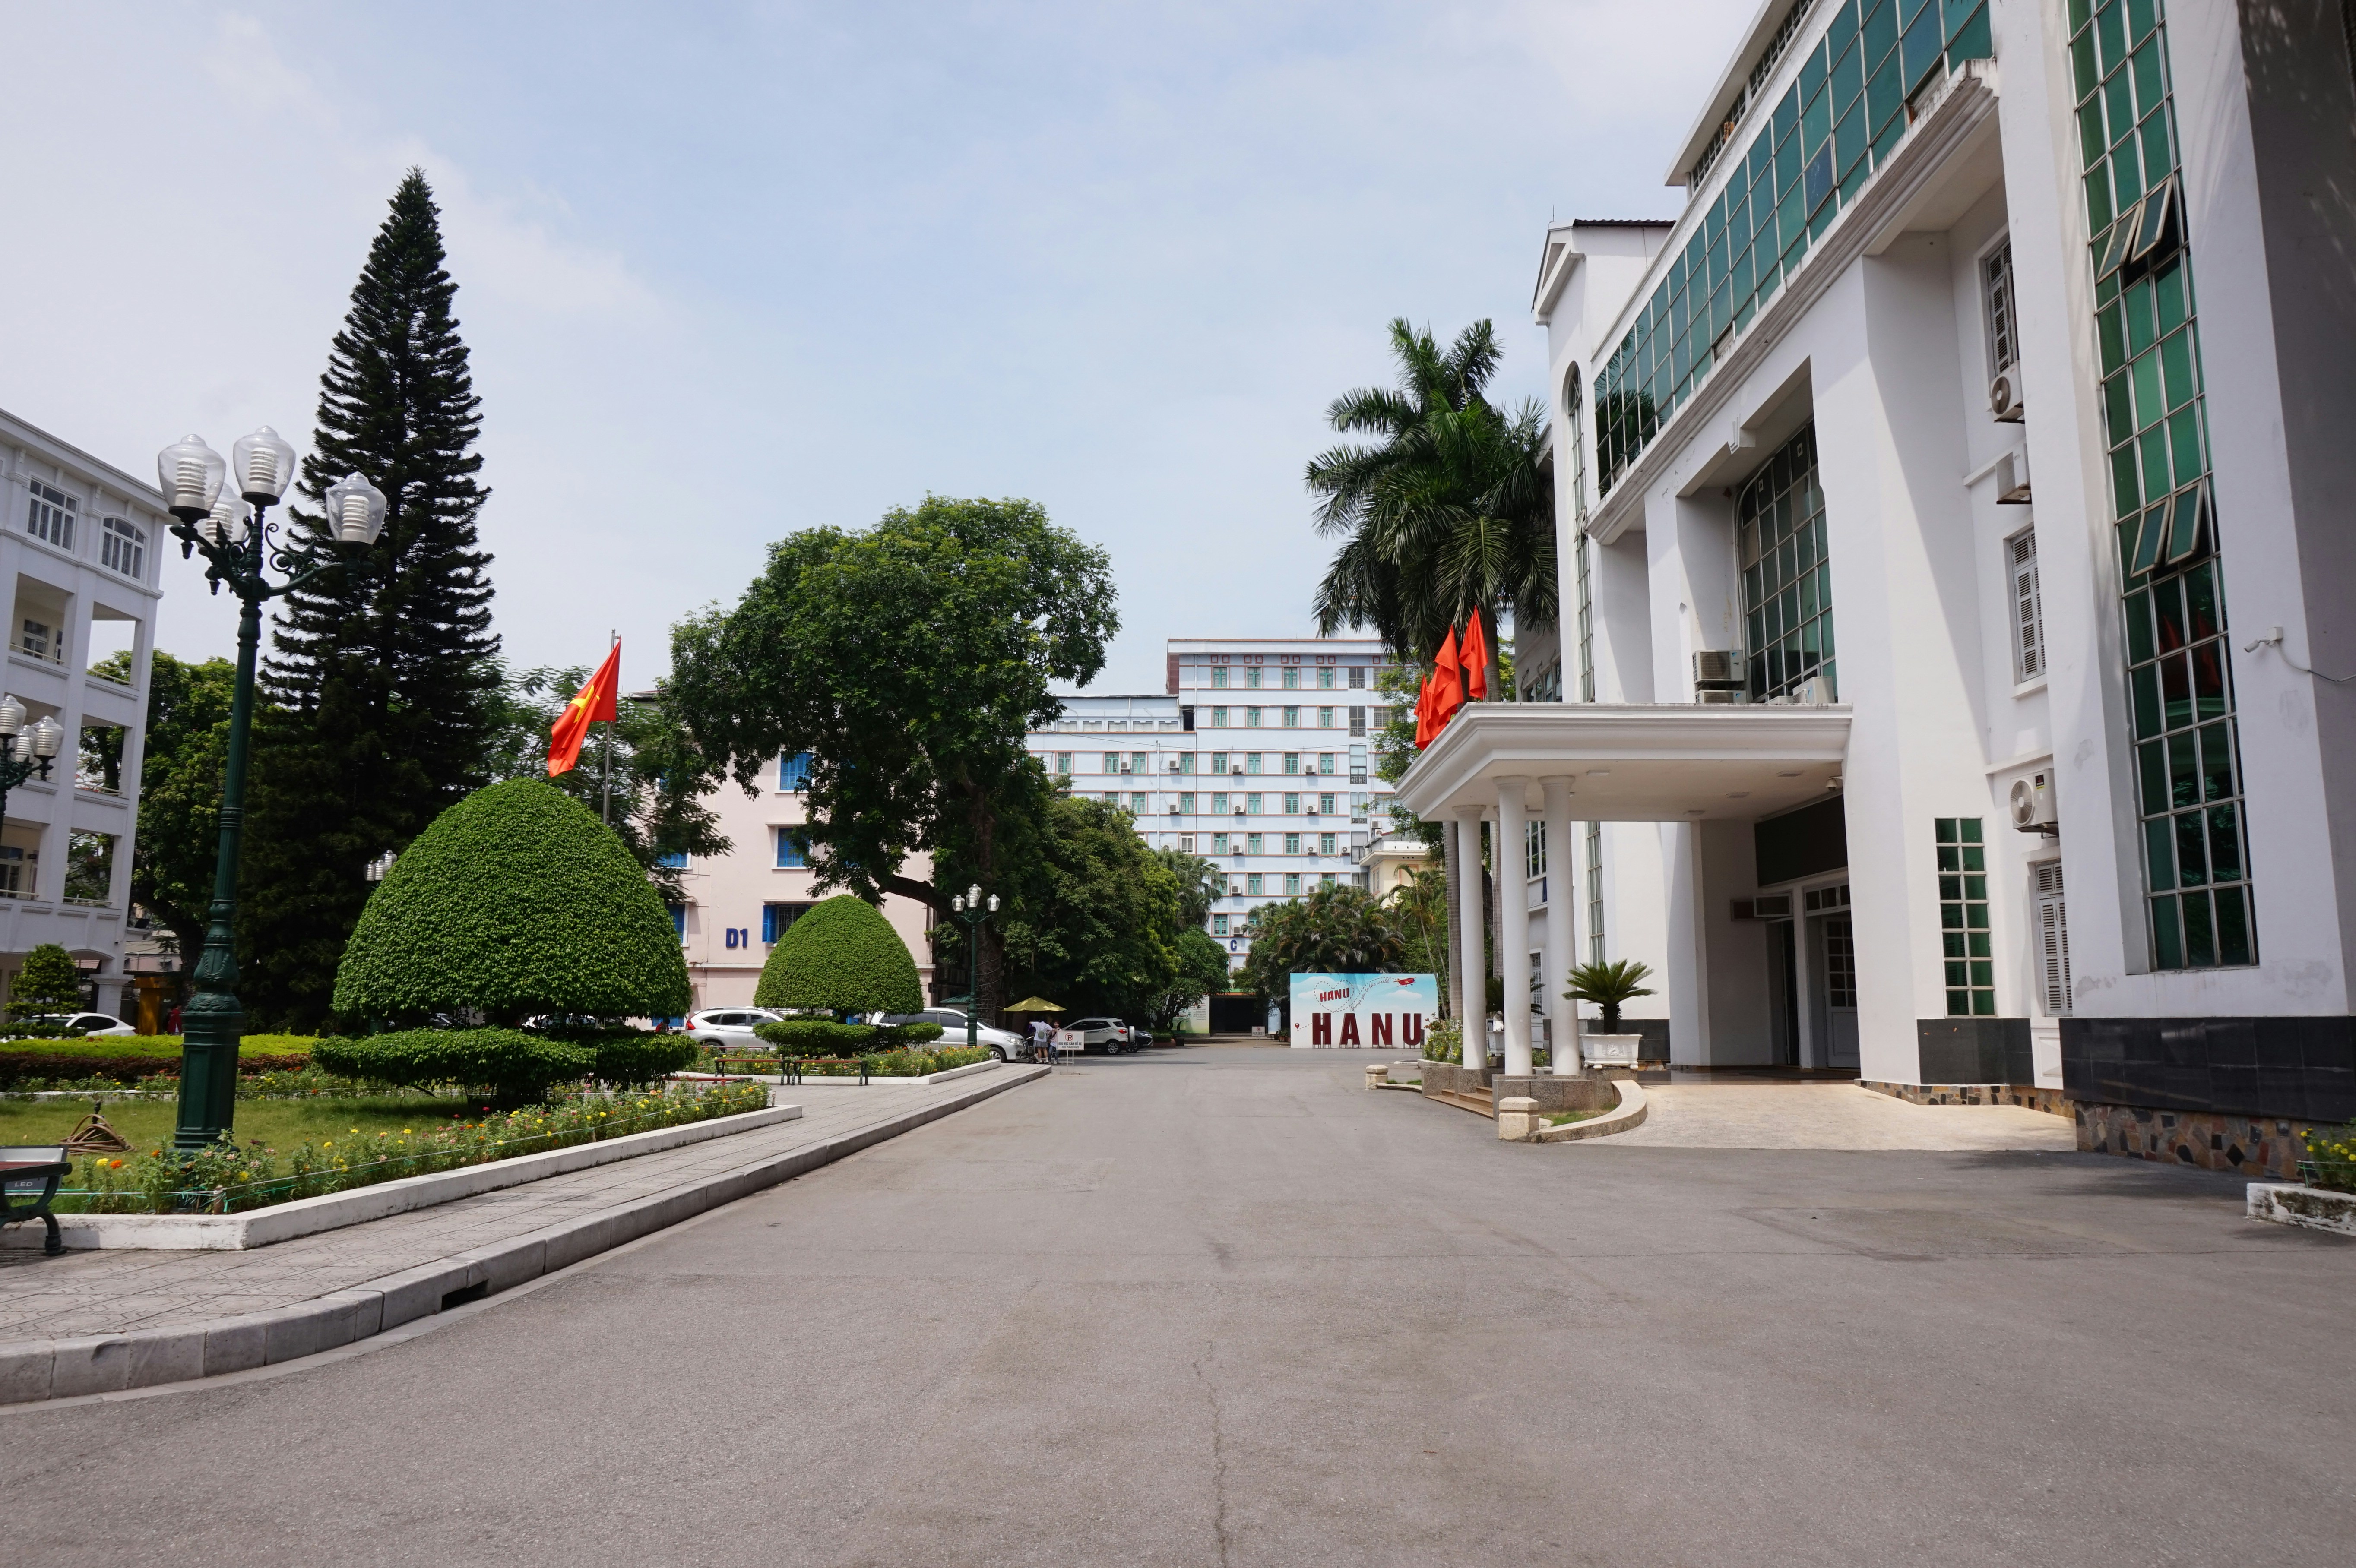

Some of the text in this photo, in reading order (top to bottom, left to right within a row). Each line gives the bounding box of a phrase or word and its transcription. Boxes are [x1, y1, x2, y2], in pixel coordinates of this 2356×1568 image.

[726, 928, 747, 948] D1
[1230, 939, 1237, 951] C
[1320, 987, 1349, 1002] HANU
[1351, 999, 1362, 1011] brings
[1312, 1013, 1422, 1046] HANU
